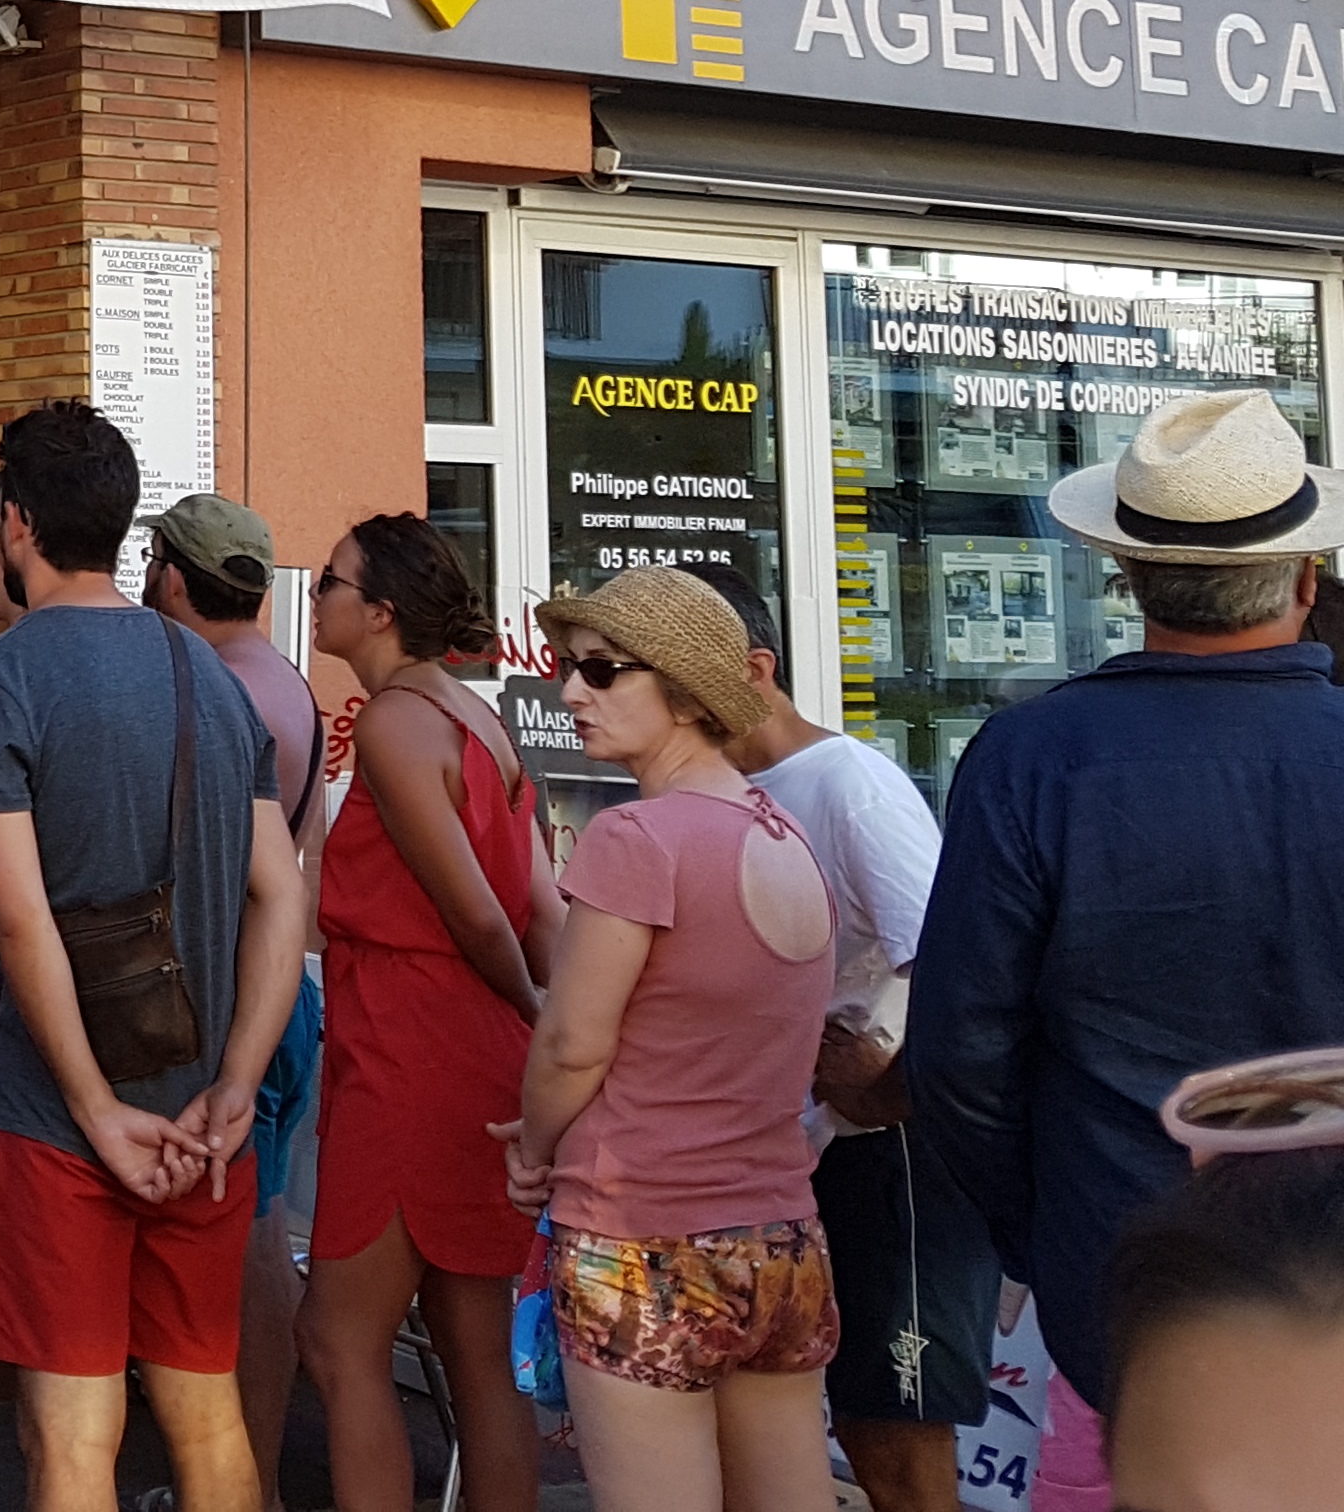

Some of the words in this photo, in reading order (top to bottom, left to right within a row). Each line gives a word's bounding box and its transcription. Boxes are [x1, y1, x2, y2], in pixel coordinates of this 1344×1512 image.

[1215, 13, 1344, 114] CA
[102, 250, 120, 258] AUX
[122, 251, 160, 261] DELICES
[162, 254, 203, 264] GLACEES
[107, 260, 146, 269] GLACIER
[149, 263, 197, 273] FABRICANT
[96, 274, 134, 285] CORNET
[971, 286, 1128, 327] TRANSACTIONS
[95, 344, 120, 354] POTS
[871, 319, 996, 358] LOCATIONS
[1002, 329, 1157, 369] SAISONNIERES
[96, 370, 133, 381] GAUFRE
[572, 376, 694, 417] AGENCE
[701, 381, 759, 413] CAP
[953, 374, 1031, 409] SYNDIC
[1036, 380, 1064, 411] DE
[1070, 383, 1202, 414] COPROPR
[570, 472, 649, 500] Philippe
[653, 476, 754, 499] GATIGNOL
[581, 514, 632, 529] EXPERT
[634, 515, 706, 531] IMMOBILIER
[708, 518, 746, 532] FNAIM
[599, 547, 623, 568] 05
[627, 548, 651, 568] 56
[655, 549, 677, 567] 54
